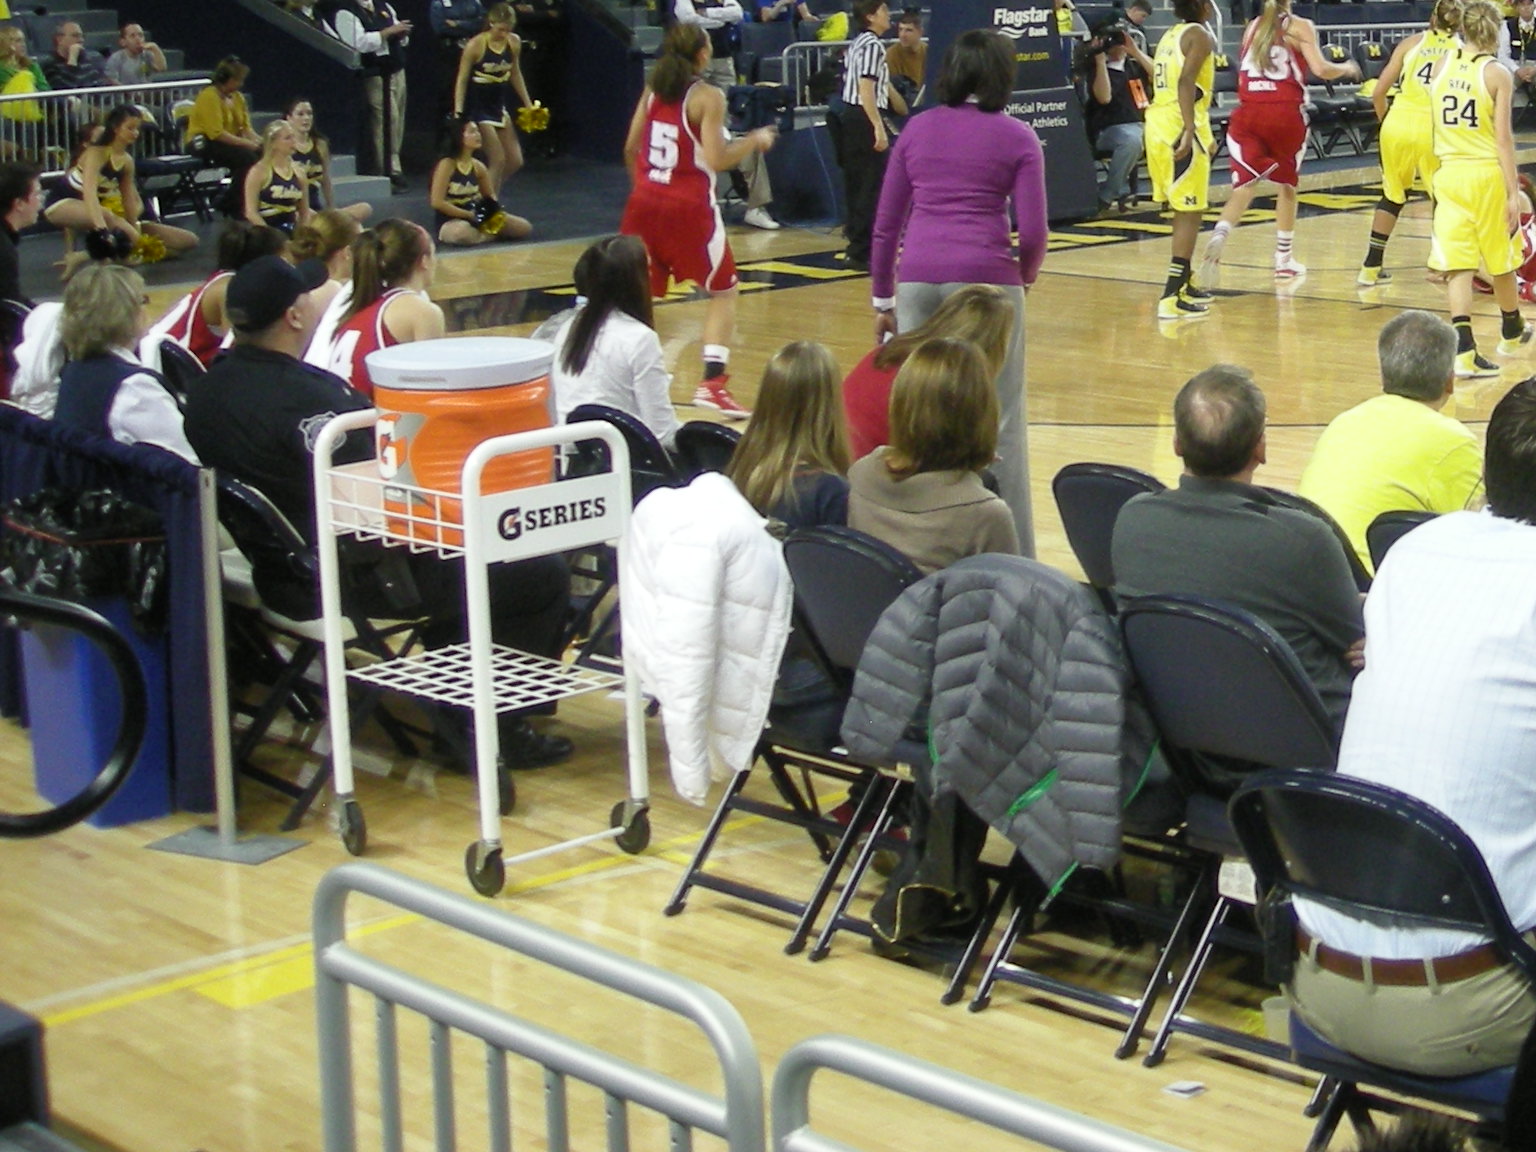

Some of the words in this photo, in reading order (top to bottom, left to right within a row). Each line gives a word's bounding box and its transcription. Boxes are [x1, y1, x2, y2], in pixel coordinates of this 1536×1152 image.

[994, 6, 1053, 27] Flagstar
[1028, 26, 1048, 37] Bank
[1004, 102, 1035, 115] Official
[1036, 102, 1067, 112] Partner
[1442, 94, 1479, 128] 24
[1032, 116, 1068, 128] Athletics
[649, 121, 680, 168] 5
[497, 508, 522, 541] G
[525, 497, 606, 531] SERIES
